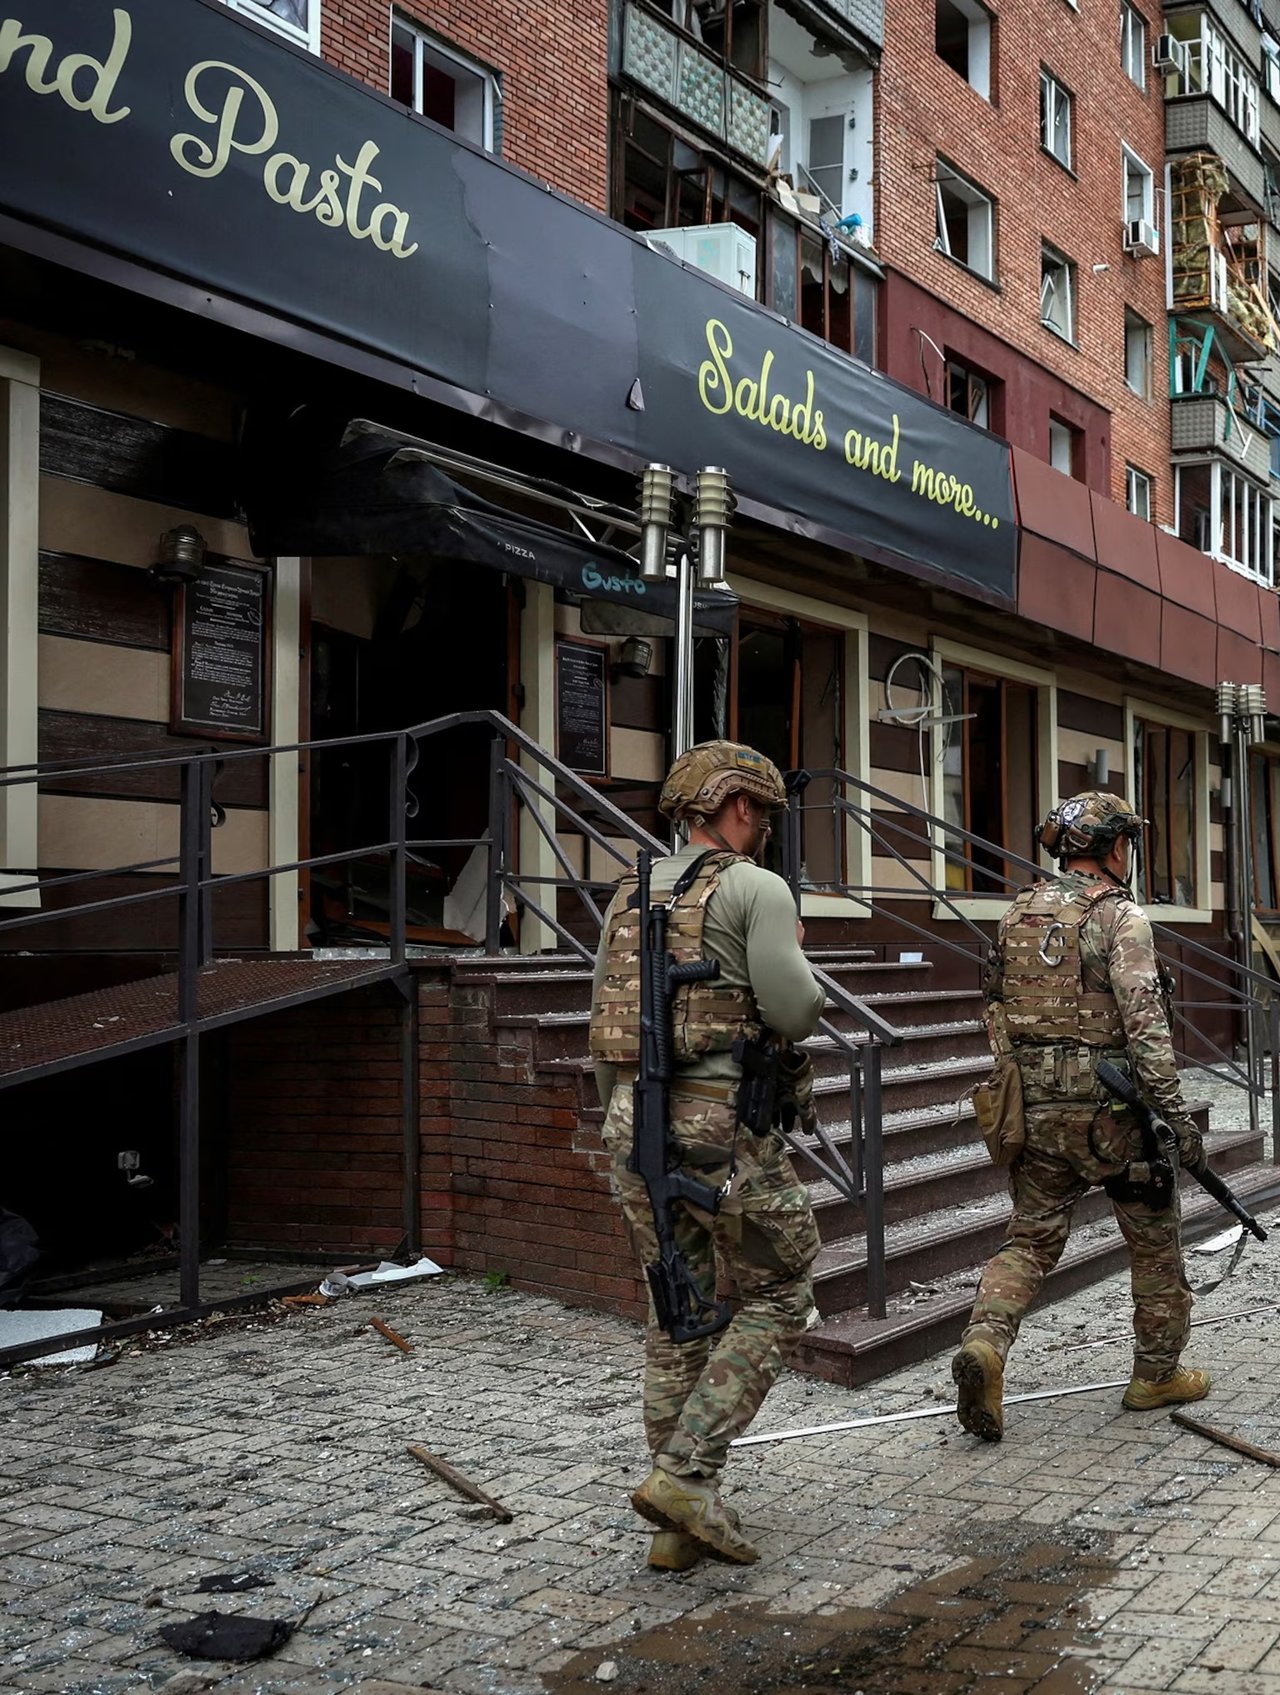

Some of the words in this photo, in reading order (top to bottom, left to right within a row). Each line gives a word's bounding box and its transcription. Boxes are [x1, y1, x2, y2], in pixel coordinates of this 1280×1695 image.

[169, 59, 420, 260] Pasta
[698, 318, 828, 451] Salads
[844, 413, 902, 484] and
[911, 459, 1000, 530] more...
[504, 543, 536, 561] PIZZA
[581, 560, 647, 596] Gusto
